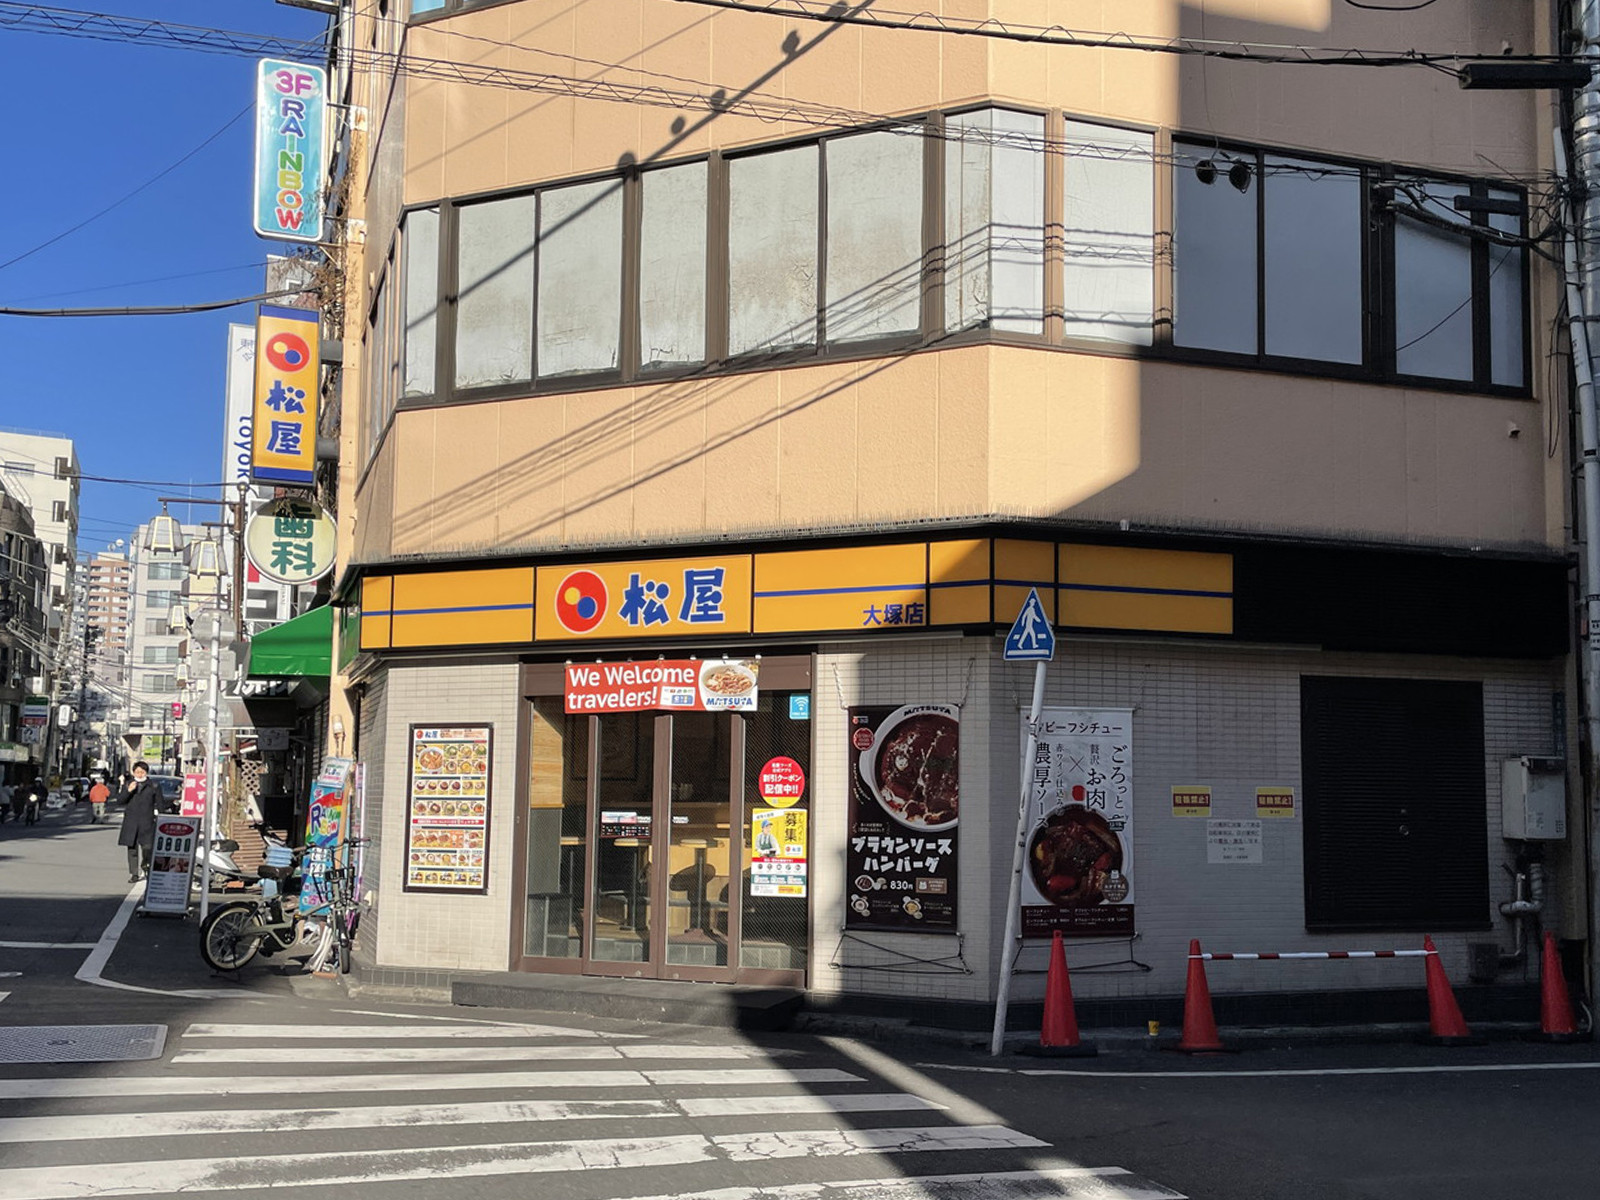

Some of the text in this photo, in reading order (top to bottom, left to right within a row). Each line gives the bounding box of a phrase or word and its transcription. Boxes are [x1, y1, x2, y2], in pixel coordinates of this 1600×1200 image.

[276, 70, 313, 96] 3F
[276, 99, 304, 229] RAINBOW
[265, 379, 307, 455] 松屋
[618, 567, 726, 626] 松屋
[863, 602, 925, 626] 大塚店
[569, 665, 694, 688] We Welcome
[568, 687, 656, 709] travelers!
[1111, 744, 1128, 809] ごろっと
[851, 836, 953, 855] ブラウンソース
[863, 855, 940, 873] ハンバーグ
